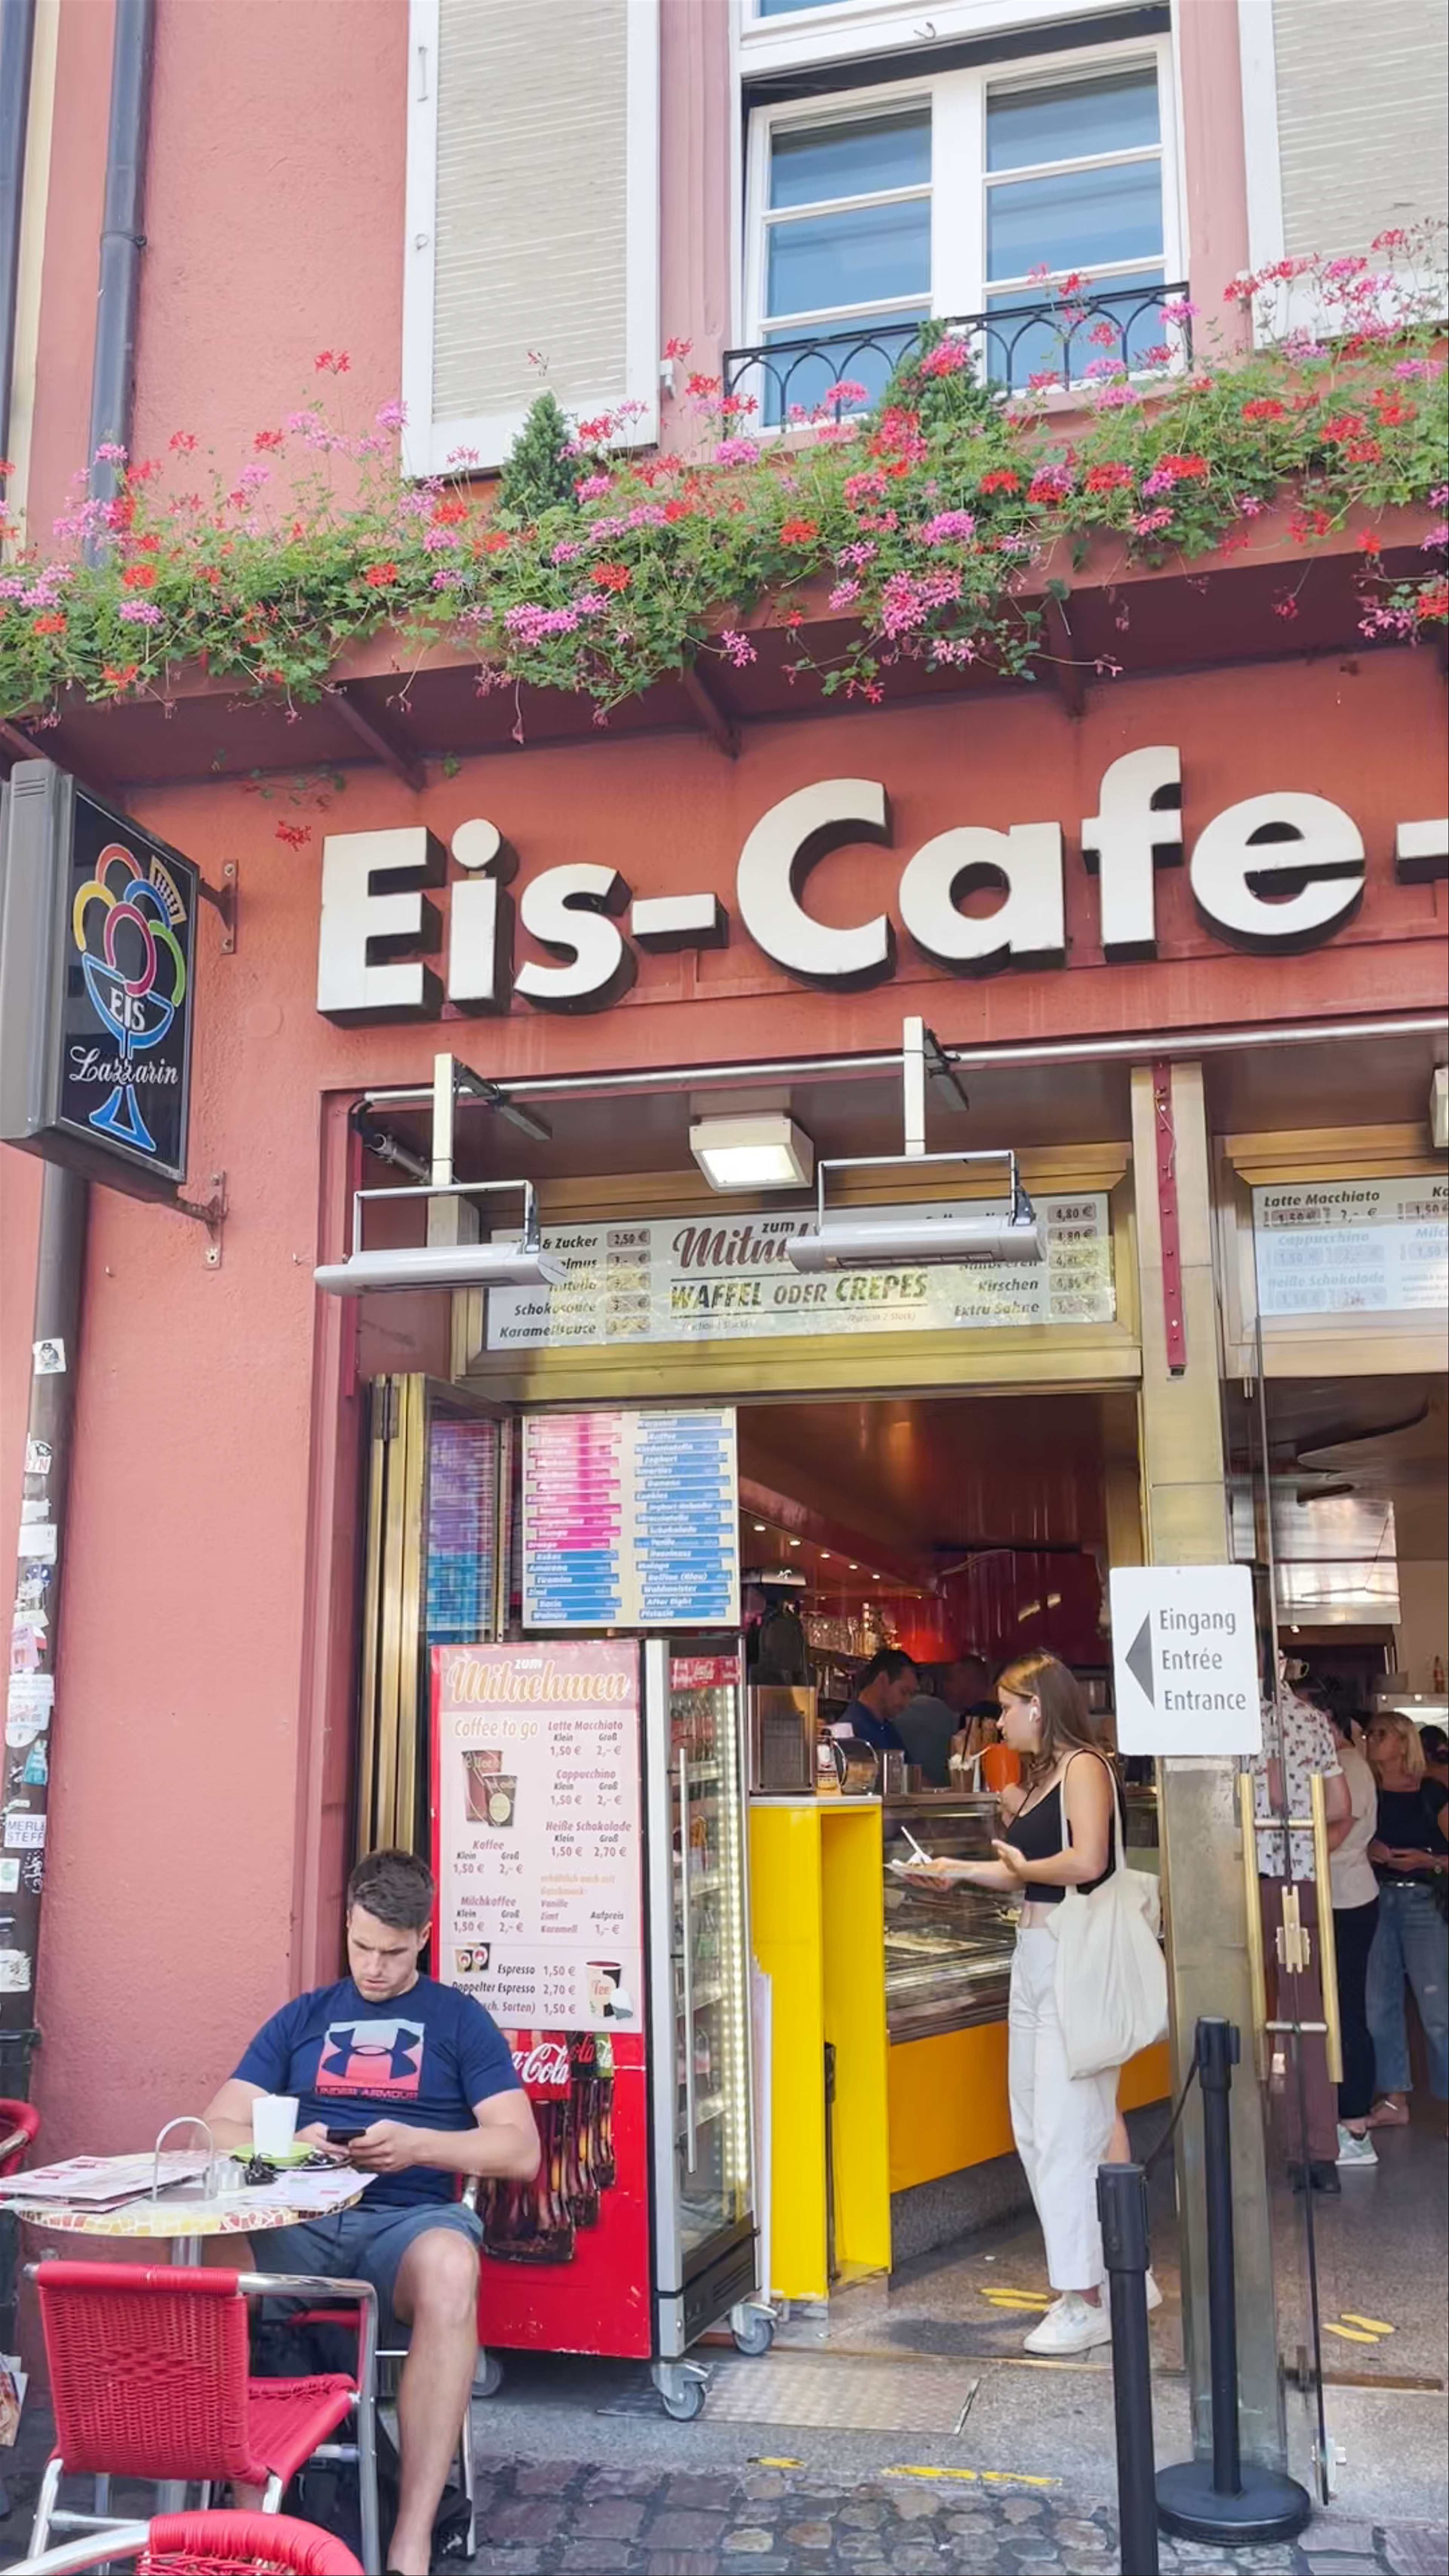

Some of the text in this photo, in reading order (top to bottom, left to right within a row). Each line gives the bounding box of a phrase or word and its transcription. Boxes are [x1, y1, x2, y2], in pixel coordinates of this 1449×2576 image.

[110, 987, 145, 1030] EIS
[69, 1046, 178, 1084] Lazzarin
[1264, 1191, 1380, 1207] Latte Macchiato
[1056, 1206, 1093, 1222] 4,80 €
[1367, 1208, 1377, 1217] €
[762, 1222, 795, 1233] zum
[543, 1235, 598, 1249] & Zucker
[638, 1230, 648, 1242] €
[978, 1278, 1038, 1292] Kirschen
[671, 1282, 762, 1310] WAFFEL
[773, 1283, 828, 1305] ODER
[1160, 1608, 1236, 1635] Eingang
[515, 1659, 543, 1669] zum
[1162, 1648, 1223, 1670] Entrée
[446, 1661, 631, 1702] Mitnehmen
[1164, 1690, 1246, 1710] Entrance
[455, 1716, 538, 1739] Coffee to go
[548, 1719, 623, 1731] Latte Macchiato
[598, 1733, 617, 1741] Groß
[550, 1746, 581, 1758] 1,50 €
[597, 1745, 621, 1757] 2,- €
[556, 1768, 616, 1781] Cappucchino
[553, 1782, 574, 1790] Klein
[598, 1781, 618, 1790] Groß
[551, 1795, 582, 1807] 1,50 €
[597, 1795, 622, 1807] 2,- €
[545, 1820, 632, 1832] Heiße Schokolade
[554, 1834, 574, 1842] Klein
[599, 1834, 619, 1842] Groß
[472, 1839, 505, 1850] Kaffee
[501, 1851, 519, 1860] Groß
[551, 1846, 583, 1858] 1,50 €
[594, 1847, 626, 1858] 2,70 €
[453, 1864, 485, 1875] 1,50 €
[499, 1863, 523, 1876] 2,- €
[461, 1895, 516, 1907] Milchkaffee
[540, 1899, 569, 1908] Vanille
[456, 1909, 477, 1918] Klein
[501, 1909, 520, 1918] Groß
[590, 1911, 624, 1921] Aufpreis
[453, 1921, 485, 1933] 1,50 €
[499, 1922, 523, 1934] 2,- €
[540, 1924, 578, 1933] Karamell
[595, 1924, 620, 1936] 1,- €
[498, 1964, 535, 1977] Espresso
[543, 1965, 576, 1977] 1,50 €
[498, 1982, 535, 1995] Espresso
[543, 1985, 576, 1997] 2,70 €
[503, 2003, 536, 2014] Sorten)
[543, 2004, 576, 2015] 1,50 €
[316, 2087, 418, 2100] UNDER ARMOUR
